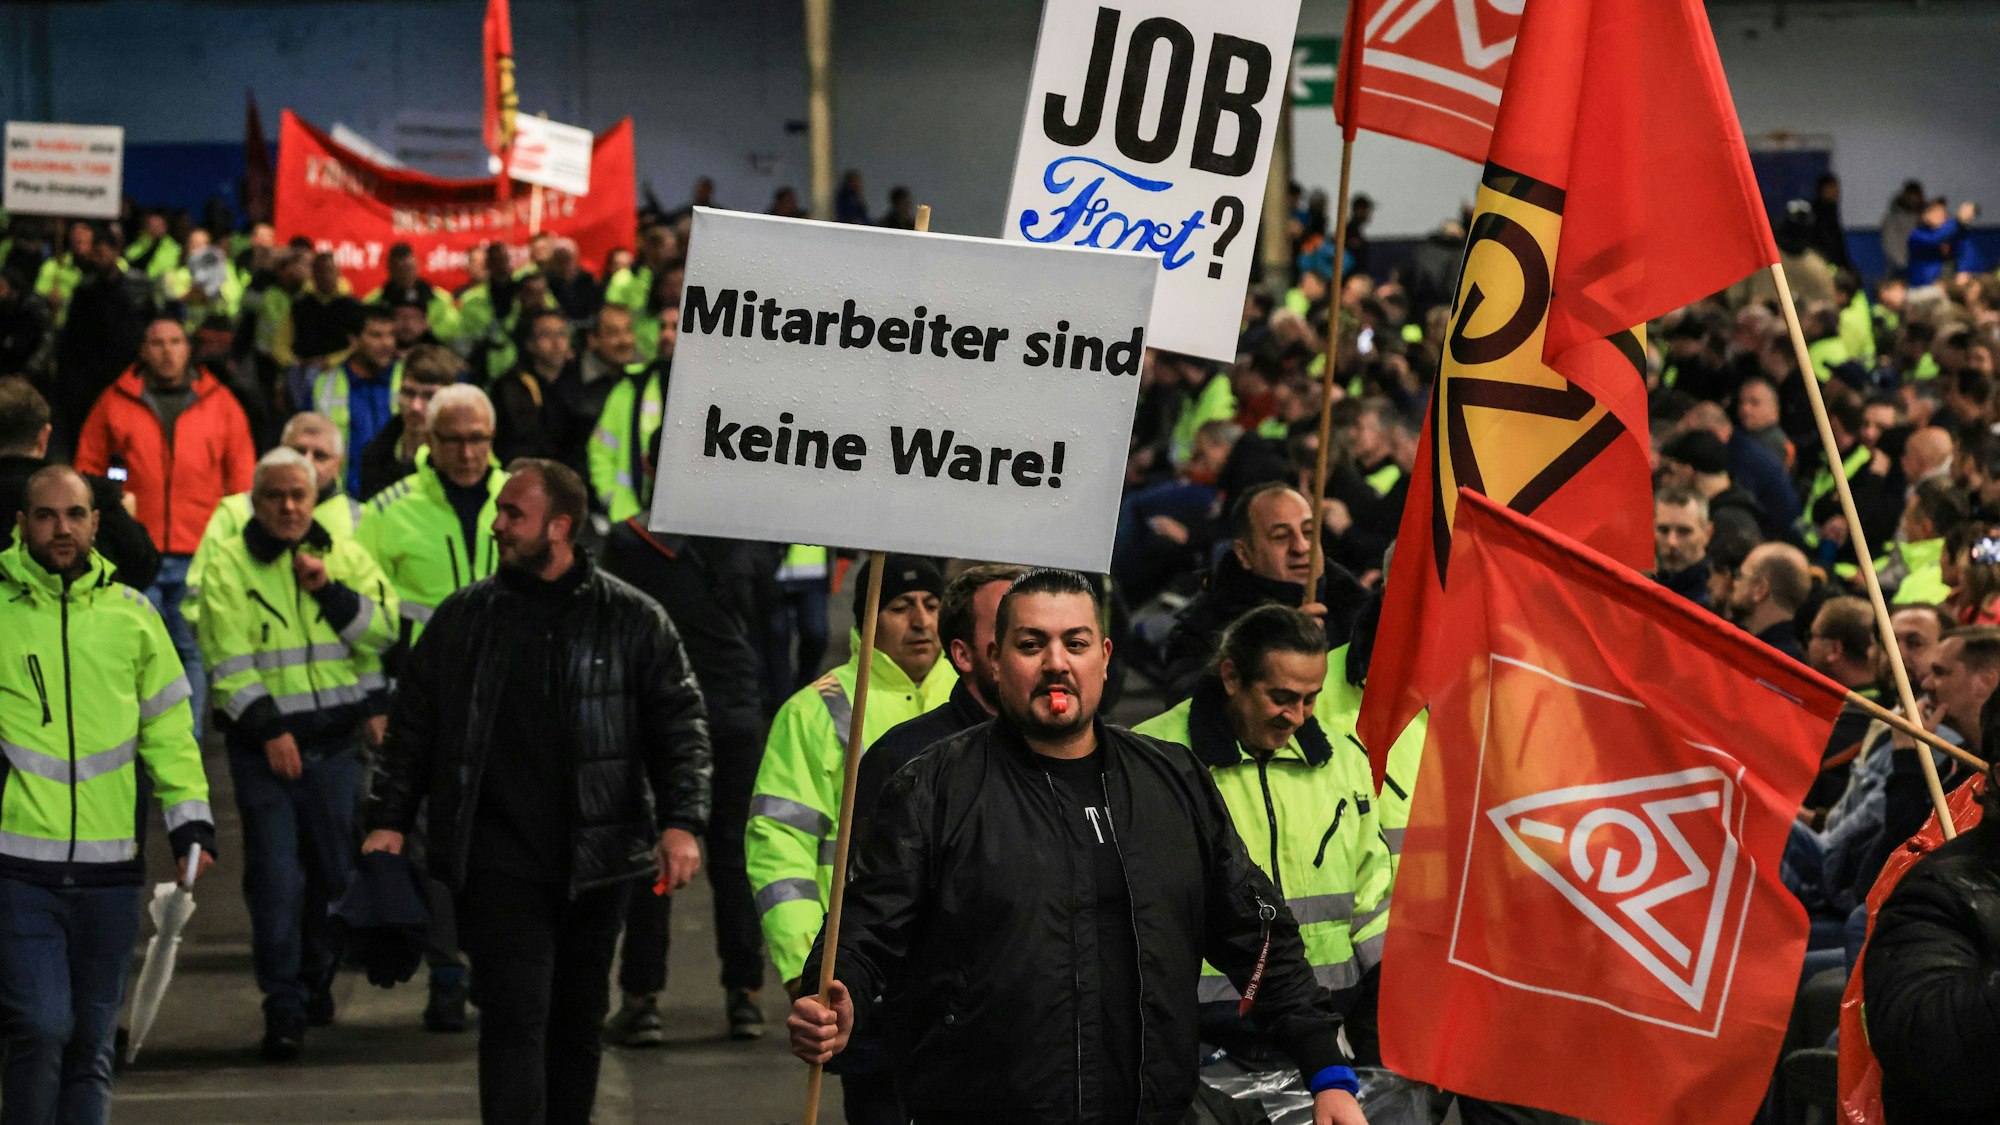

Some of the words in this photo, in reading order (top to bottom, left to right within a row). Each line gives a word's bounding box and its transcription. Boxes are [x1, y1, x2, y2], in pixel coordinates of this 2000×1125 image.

[1042, 6, 1272, 177] JOB
[681, 285, 1010, 362] Mitarbeiter
[1022, 319, 1144, 377] sind
[703, 404, 867, 472] keine
[890, 425, 1067, 489] Ware!
